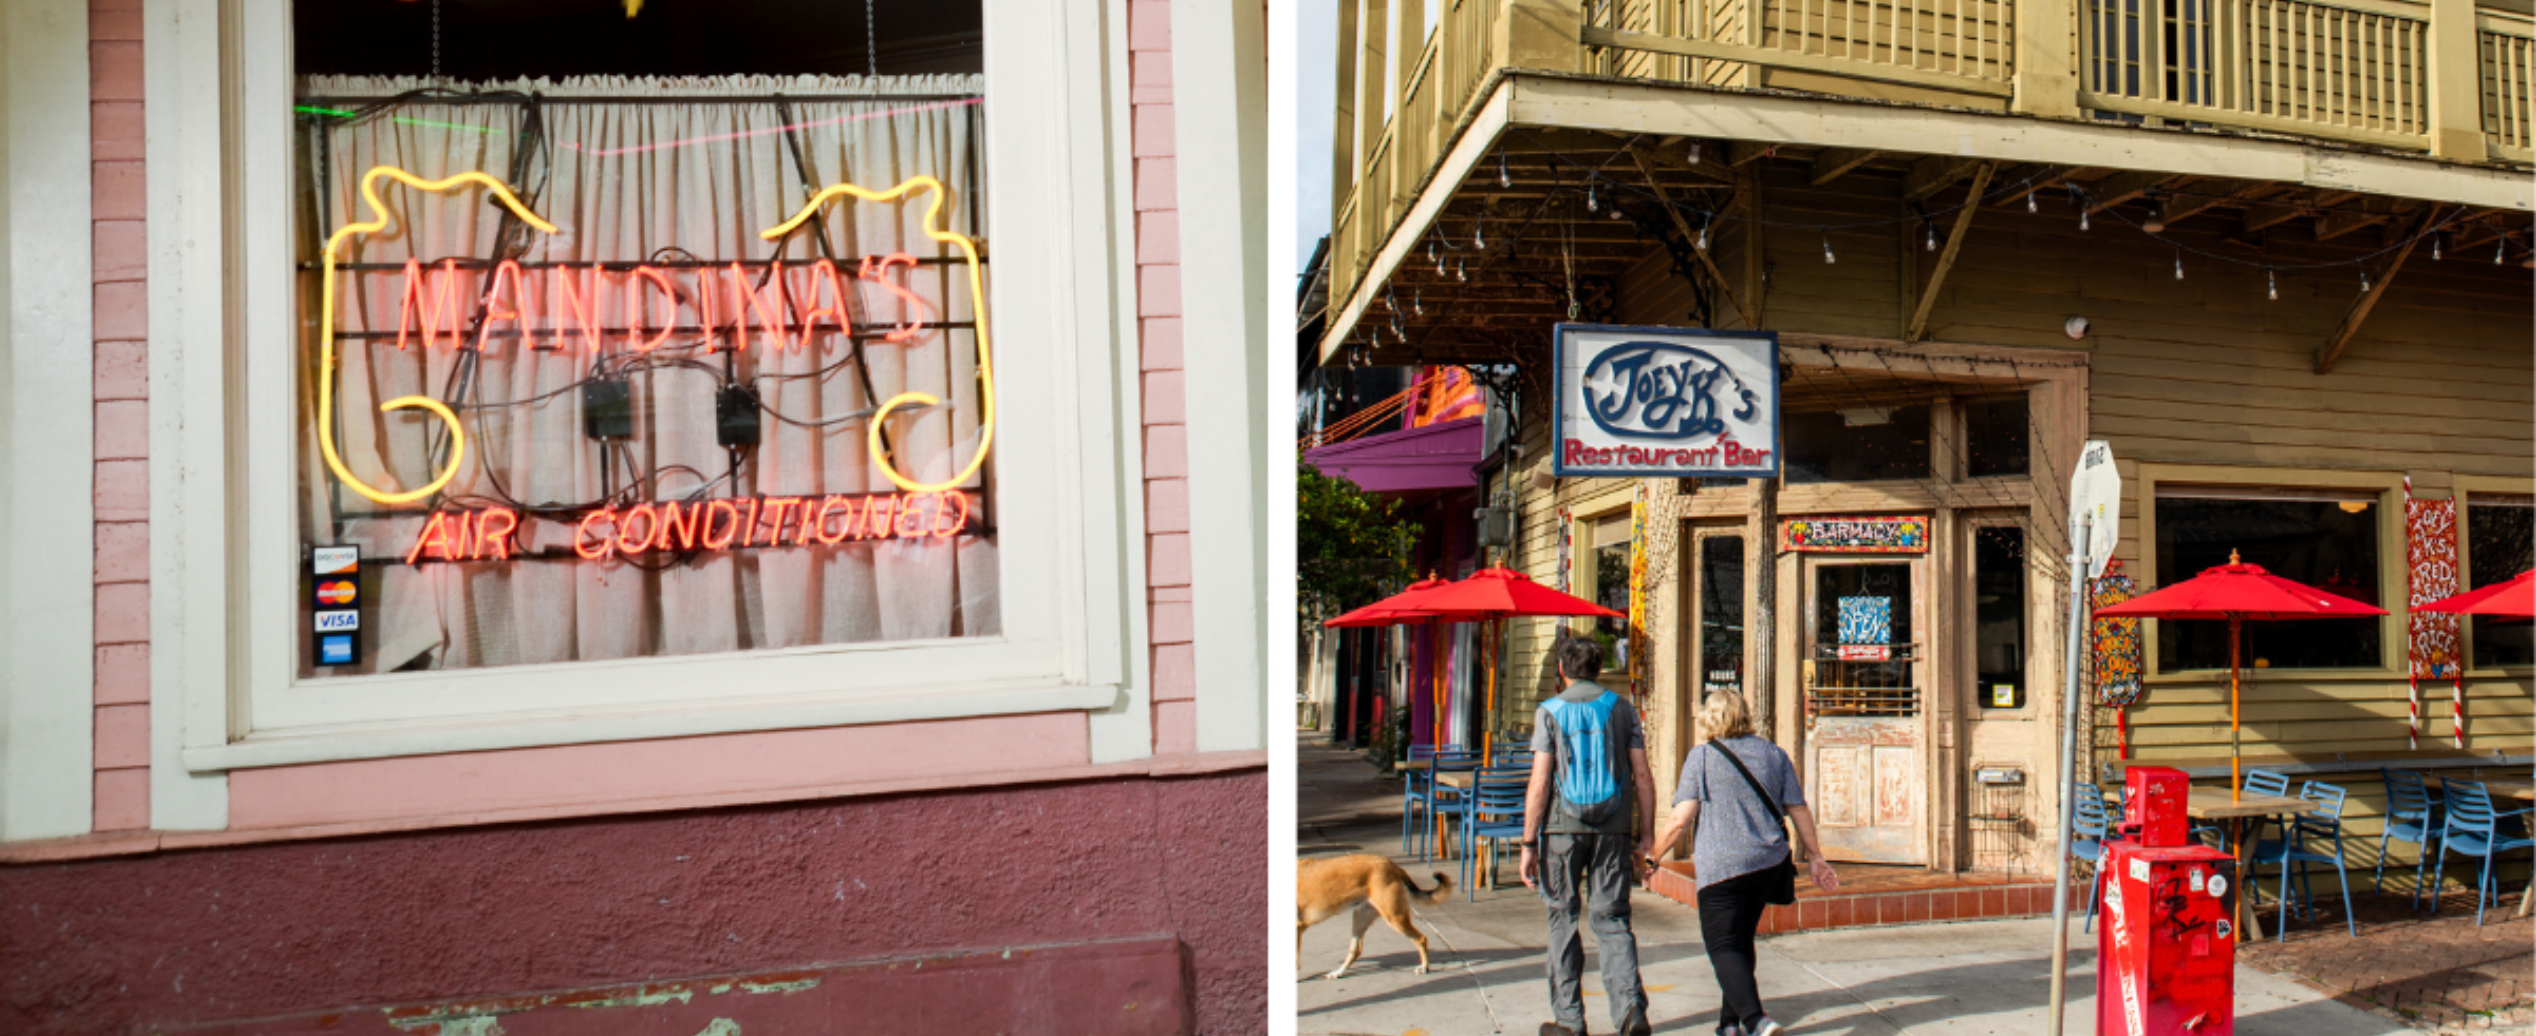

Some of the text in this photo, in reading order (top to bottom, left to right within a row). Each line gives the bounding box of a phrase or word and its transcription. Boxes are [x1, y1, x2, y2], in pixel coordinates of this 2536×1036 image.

[398, 253, 924, 353] MANDINA'S
[1564, 438, 1771, 466] Restaurant Bar
[405, 489, 969, 565] AIR CONDITIONED
[1811, 522, 1898, 541] BARMACY
[2415, 559, 2452, 584] RED
[320, 615, 356, 627] VISA
[1844, 613, 1882, 637] OPEN
[2417, 630, 2455, 659] RICE
